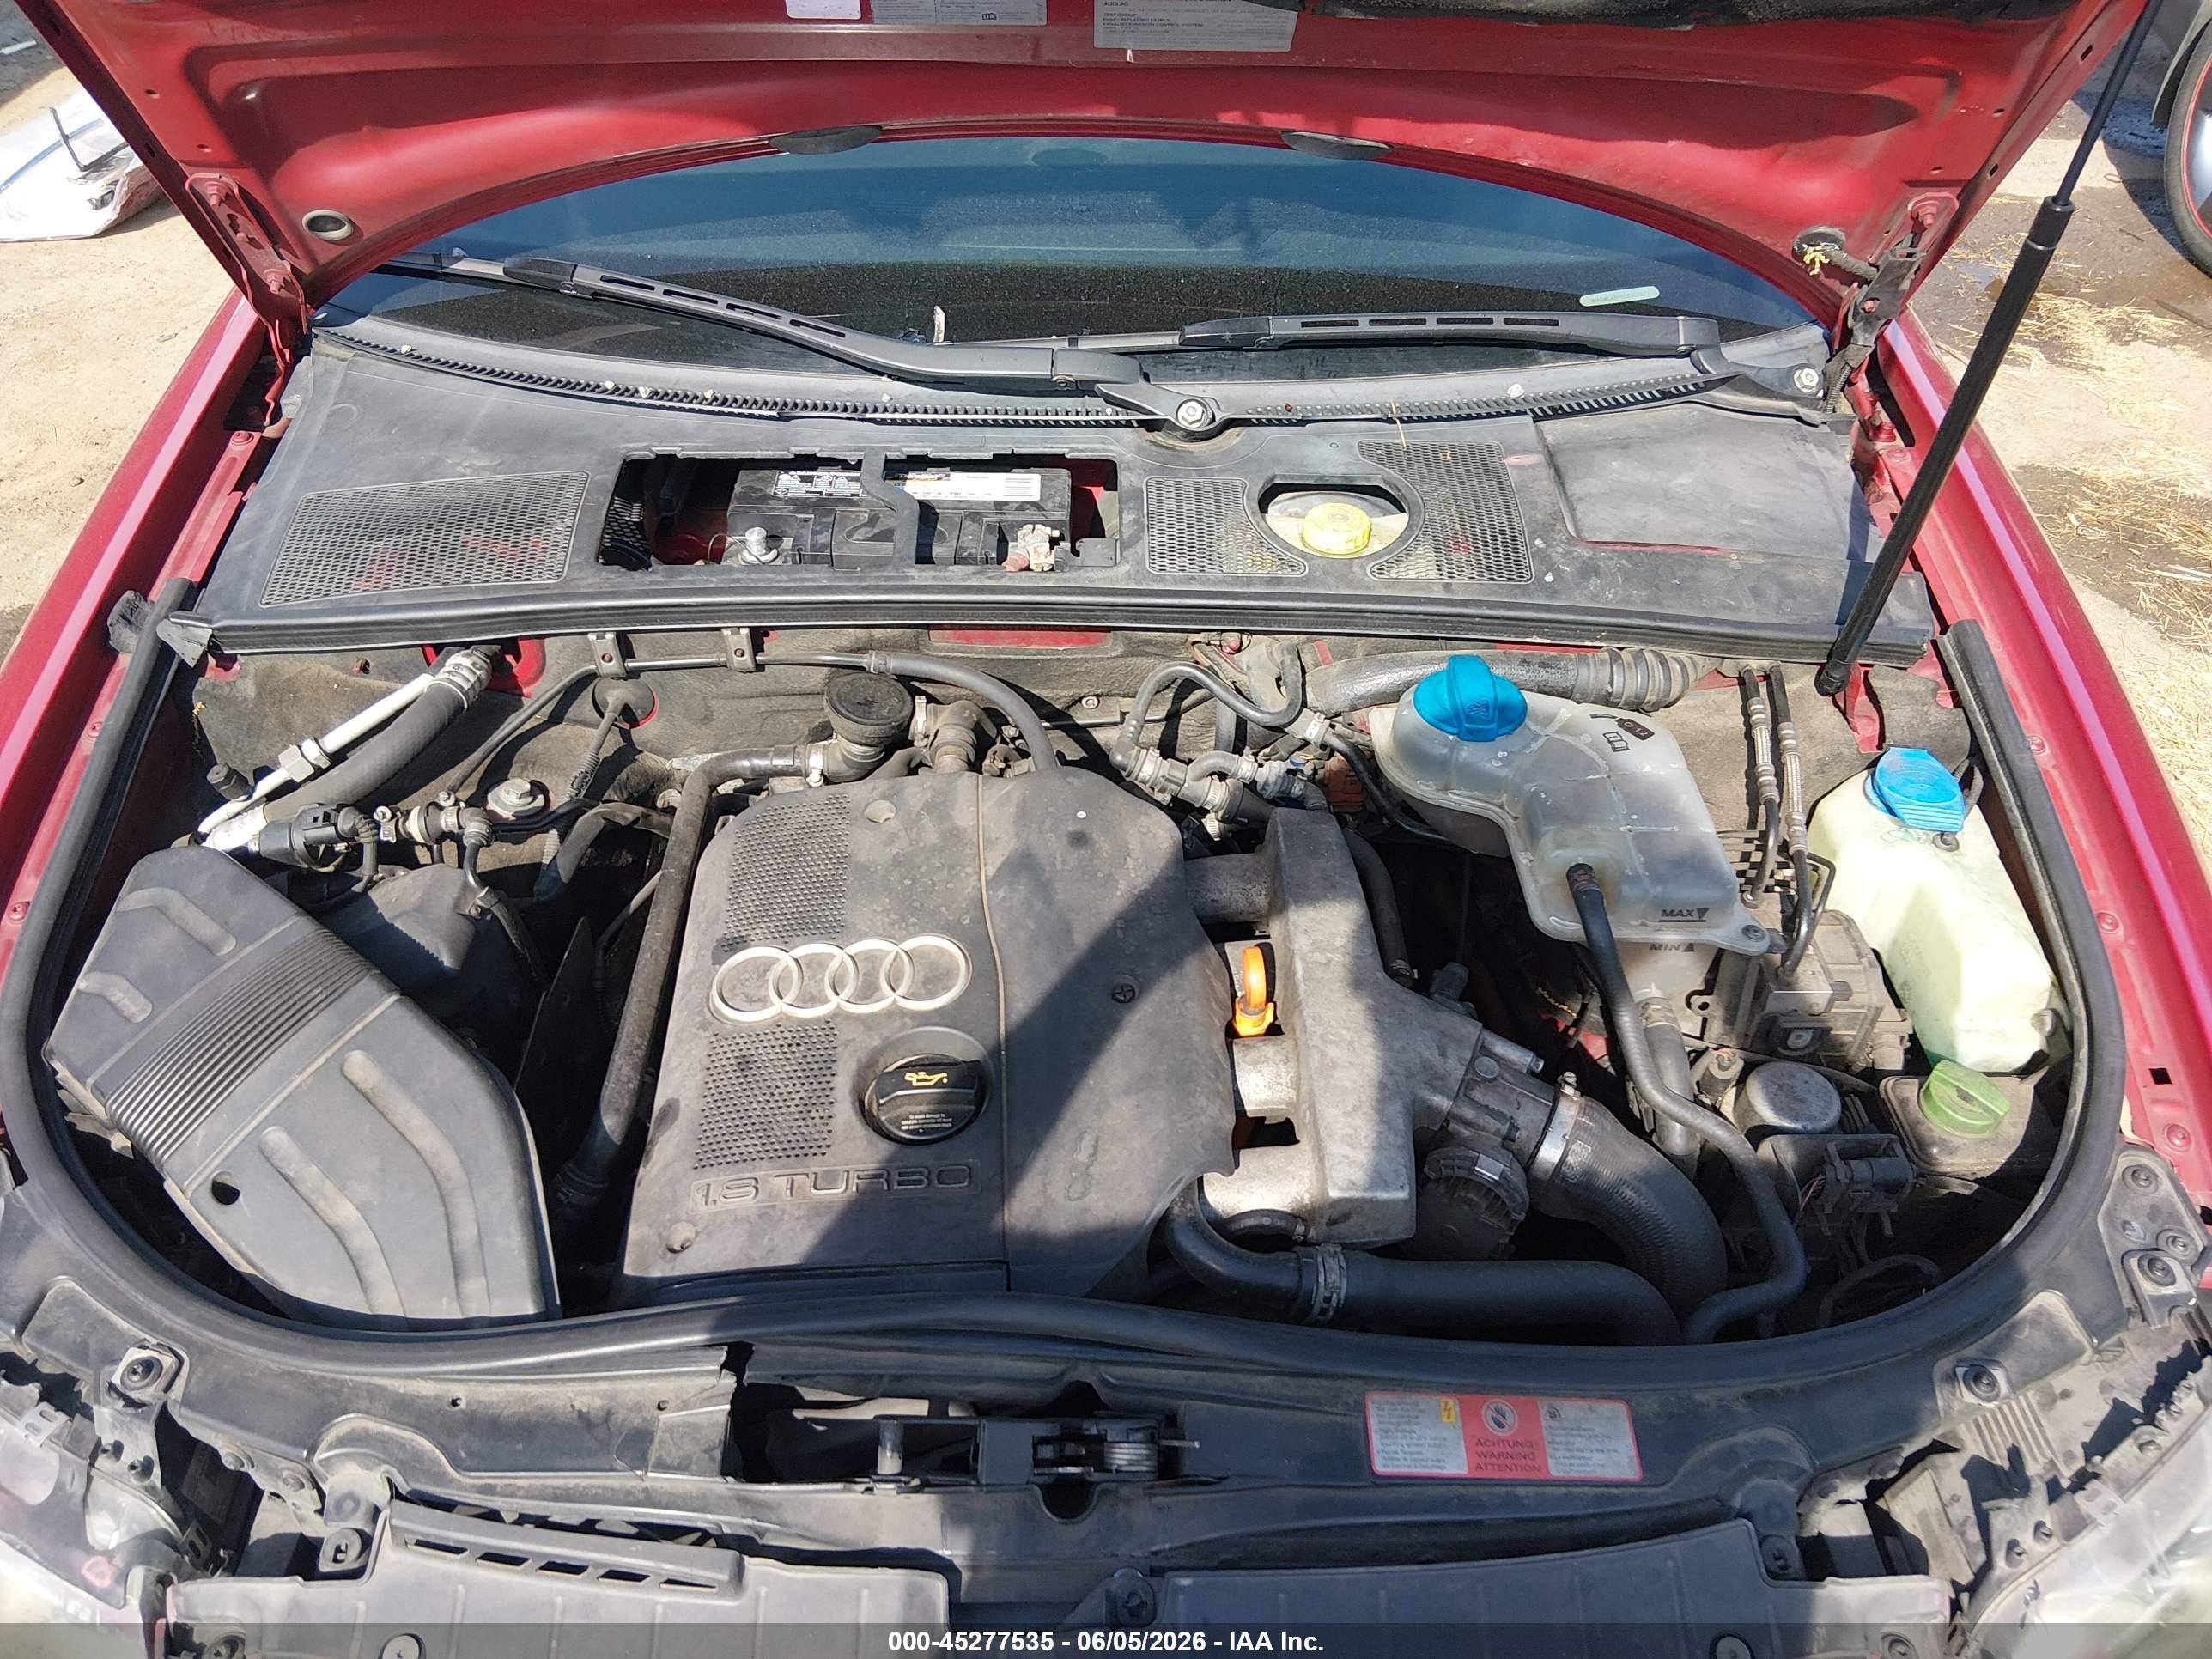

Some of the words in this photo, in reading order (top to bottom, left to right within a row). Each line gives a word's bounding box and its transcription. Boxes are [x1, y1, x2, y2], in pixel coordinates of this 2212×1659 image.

[1661, 908, 1695, 918] MAX
[1649, 943, 1680, 951] MIN
[773, 1165, 972, 1198] TURBO
[1475, 1437, 1534, 1449] ACHTUNG
[1475, 1450, 1537, 1462] WARNING
[1475, 1462, 1542, 1474] ATTENTION
